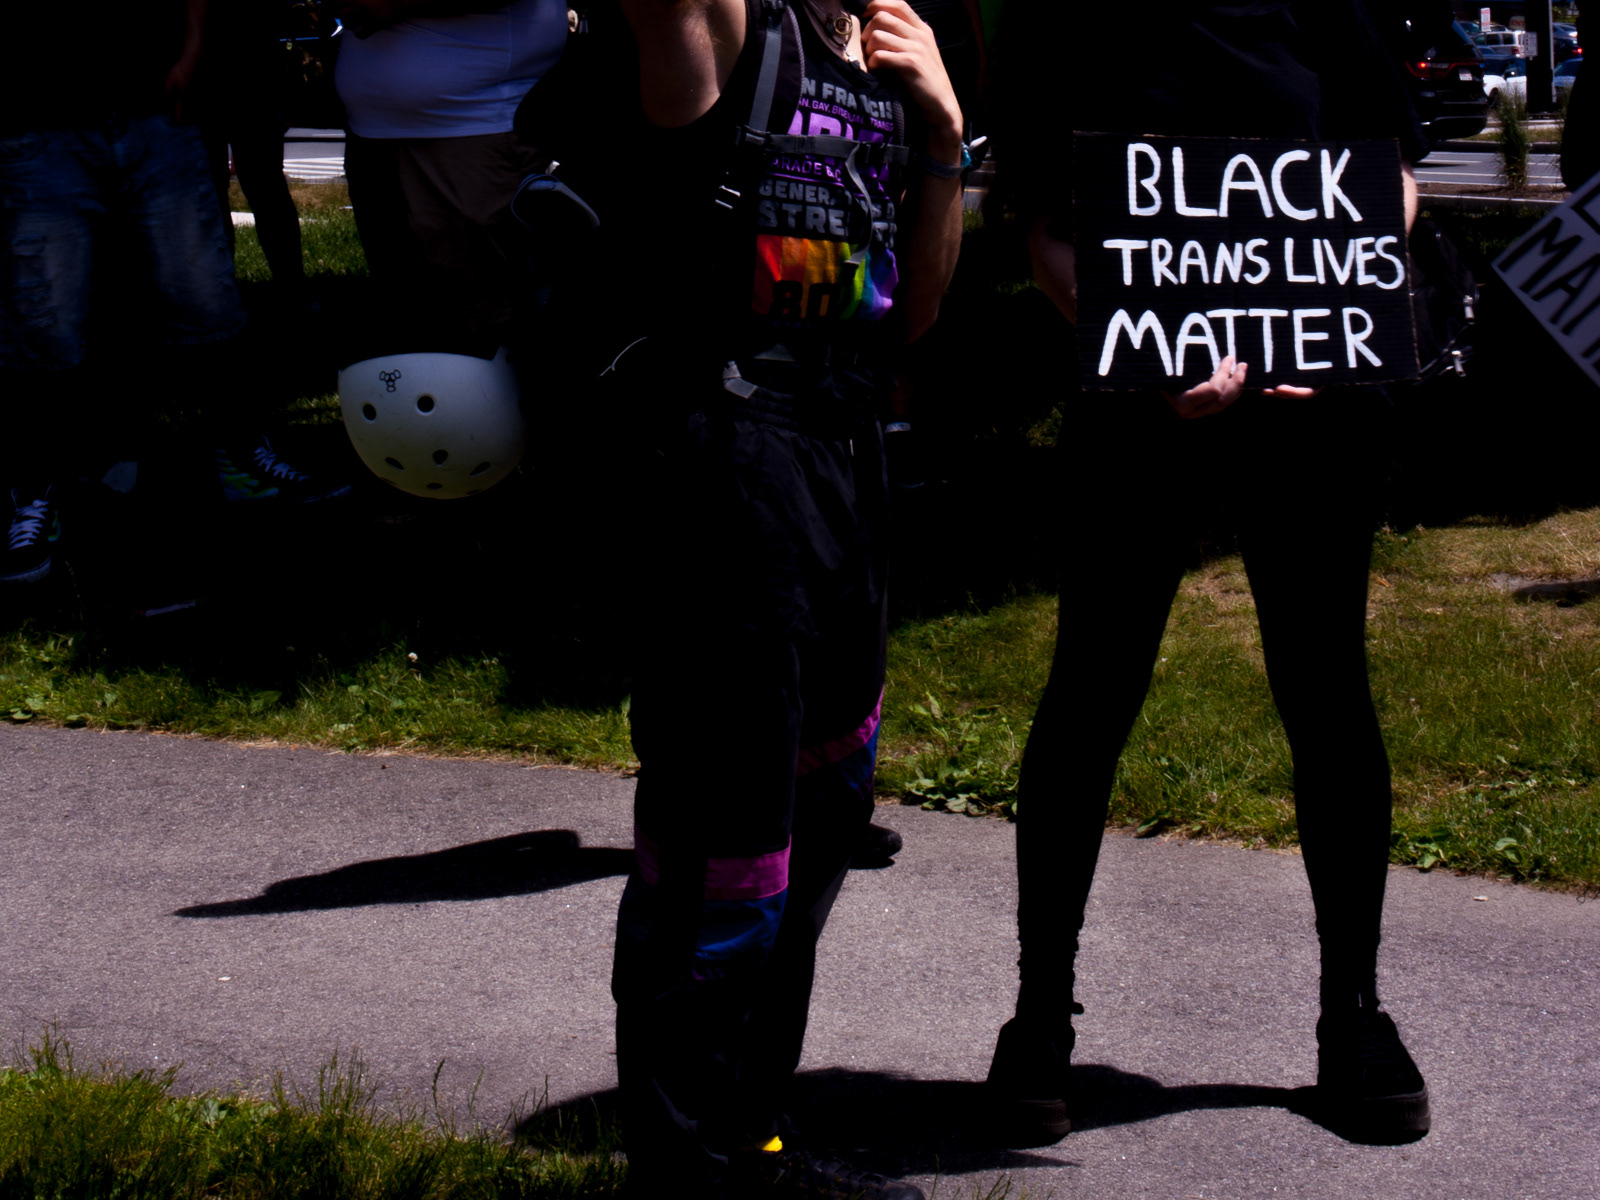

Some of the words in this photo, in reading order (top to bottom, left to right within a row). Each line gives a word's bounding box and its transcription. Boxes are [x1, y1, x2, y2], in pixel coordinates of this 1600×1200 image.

[771, 156, 823, 176] ARADE
[1126, 142, 1364, 223] BLACK
[1102, 237, 1271, 288] TRANS
[1284, 235, 1406, 291] LIVES
[1098, 307, 1384, 377] MATTER
